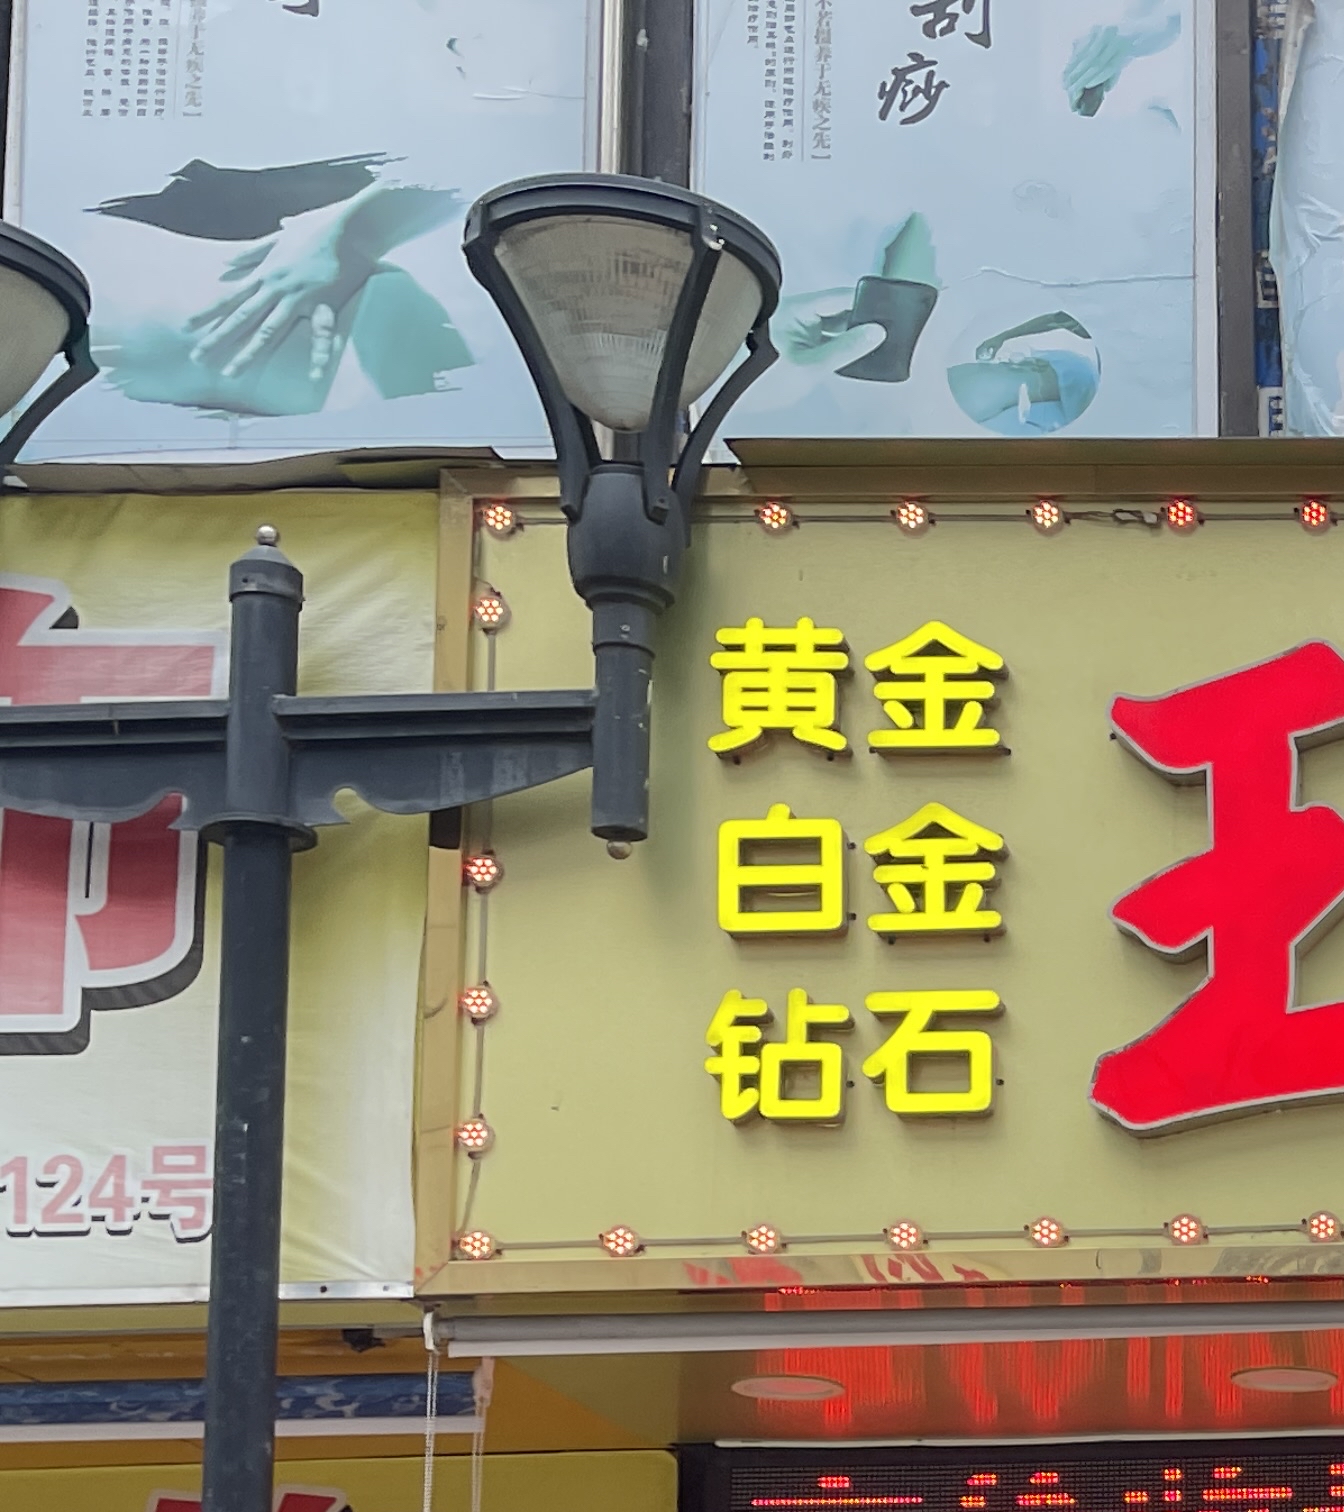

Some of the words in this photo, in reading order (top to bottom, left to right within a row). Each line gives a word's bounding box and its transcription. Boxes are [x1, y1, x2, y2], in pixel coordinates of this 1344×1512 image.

[708, 618, 1008, 758] 黄金
[716, 802, 1005, 938] 白金
[704, 988, 1004, 1125] 钻石
[0, 1145, 211, 1233] 124号
